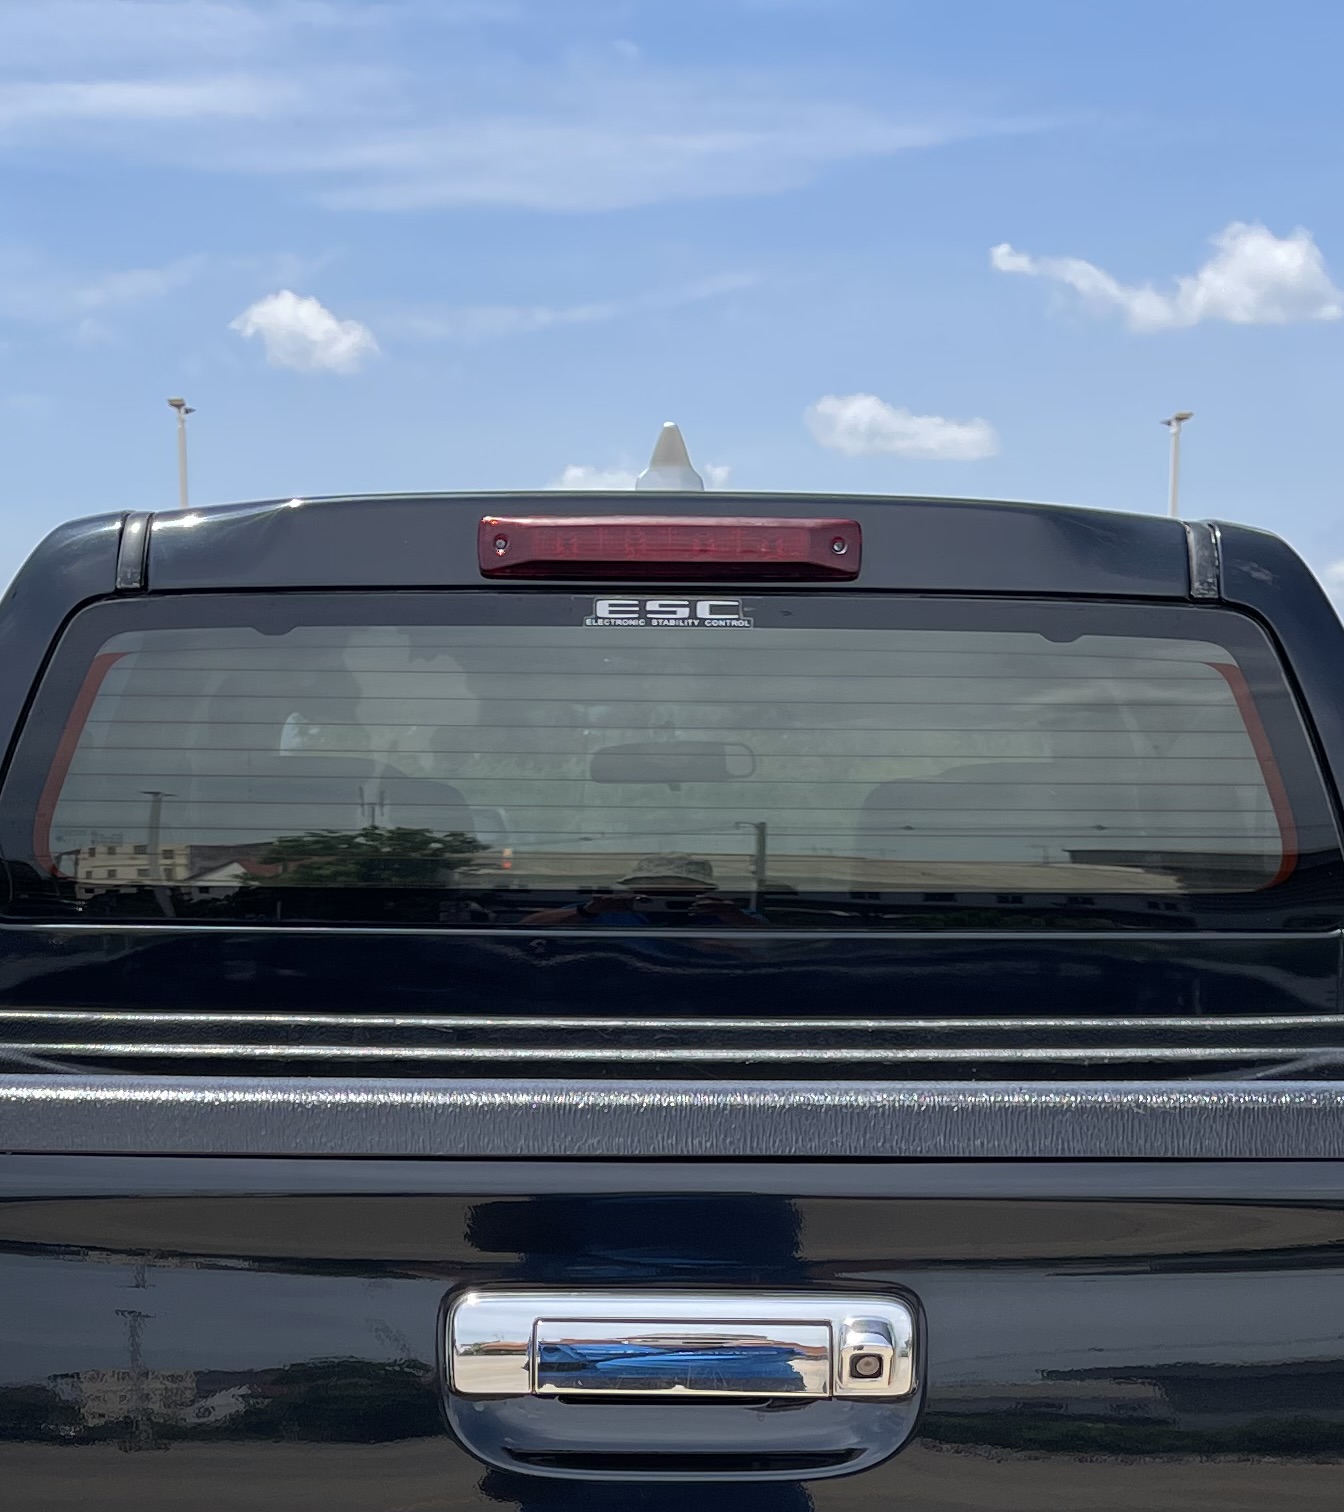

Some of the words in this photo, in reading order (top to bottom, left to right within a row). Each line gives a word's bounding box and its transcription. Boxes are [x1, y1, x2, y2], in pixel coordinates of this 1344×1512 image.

[596, 600, 740, 619] ESC
[585, 618, 646, 627] ELECTRONIC
[651, 619, 700, 627] STABILITY
[705, 619, 750, 628] CONTROL
